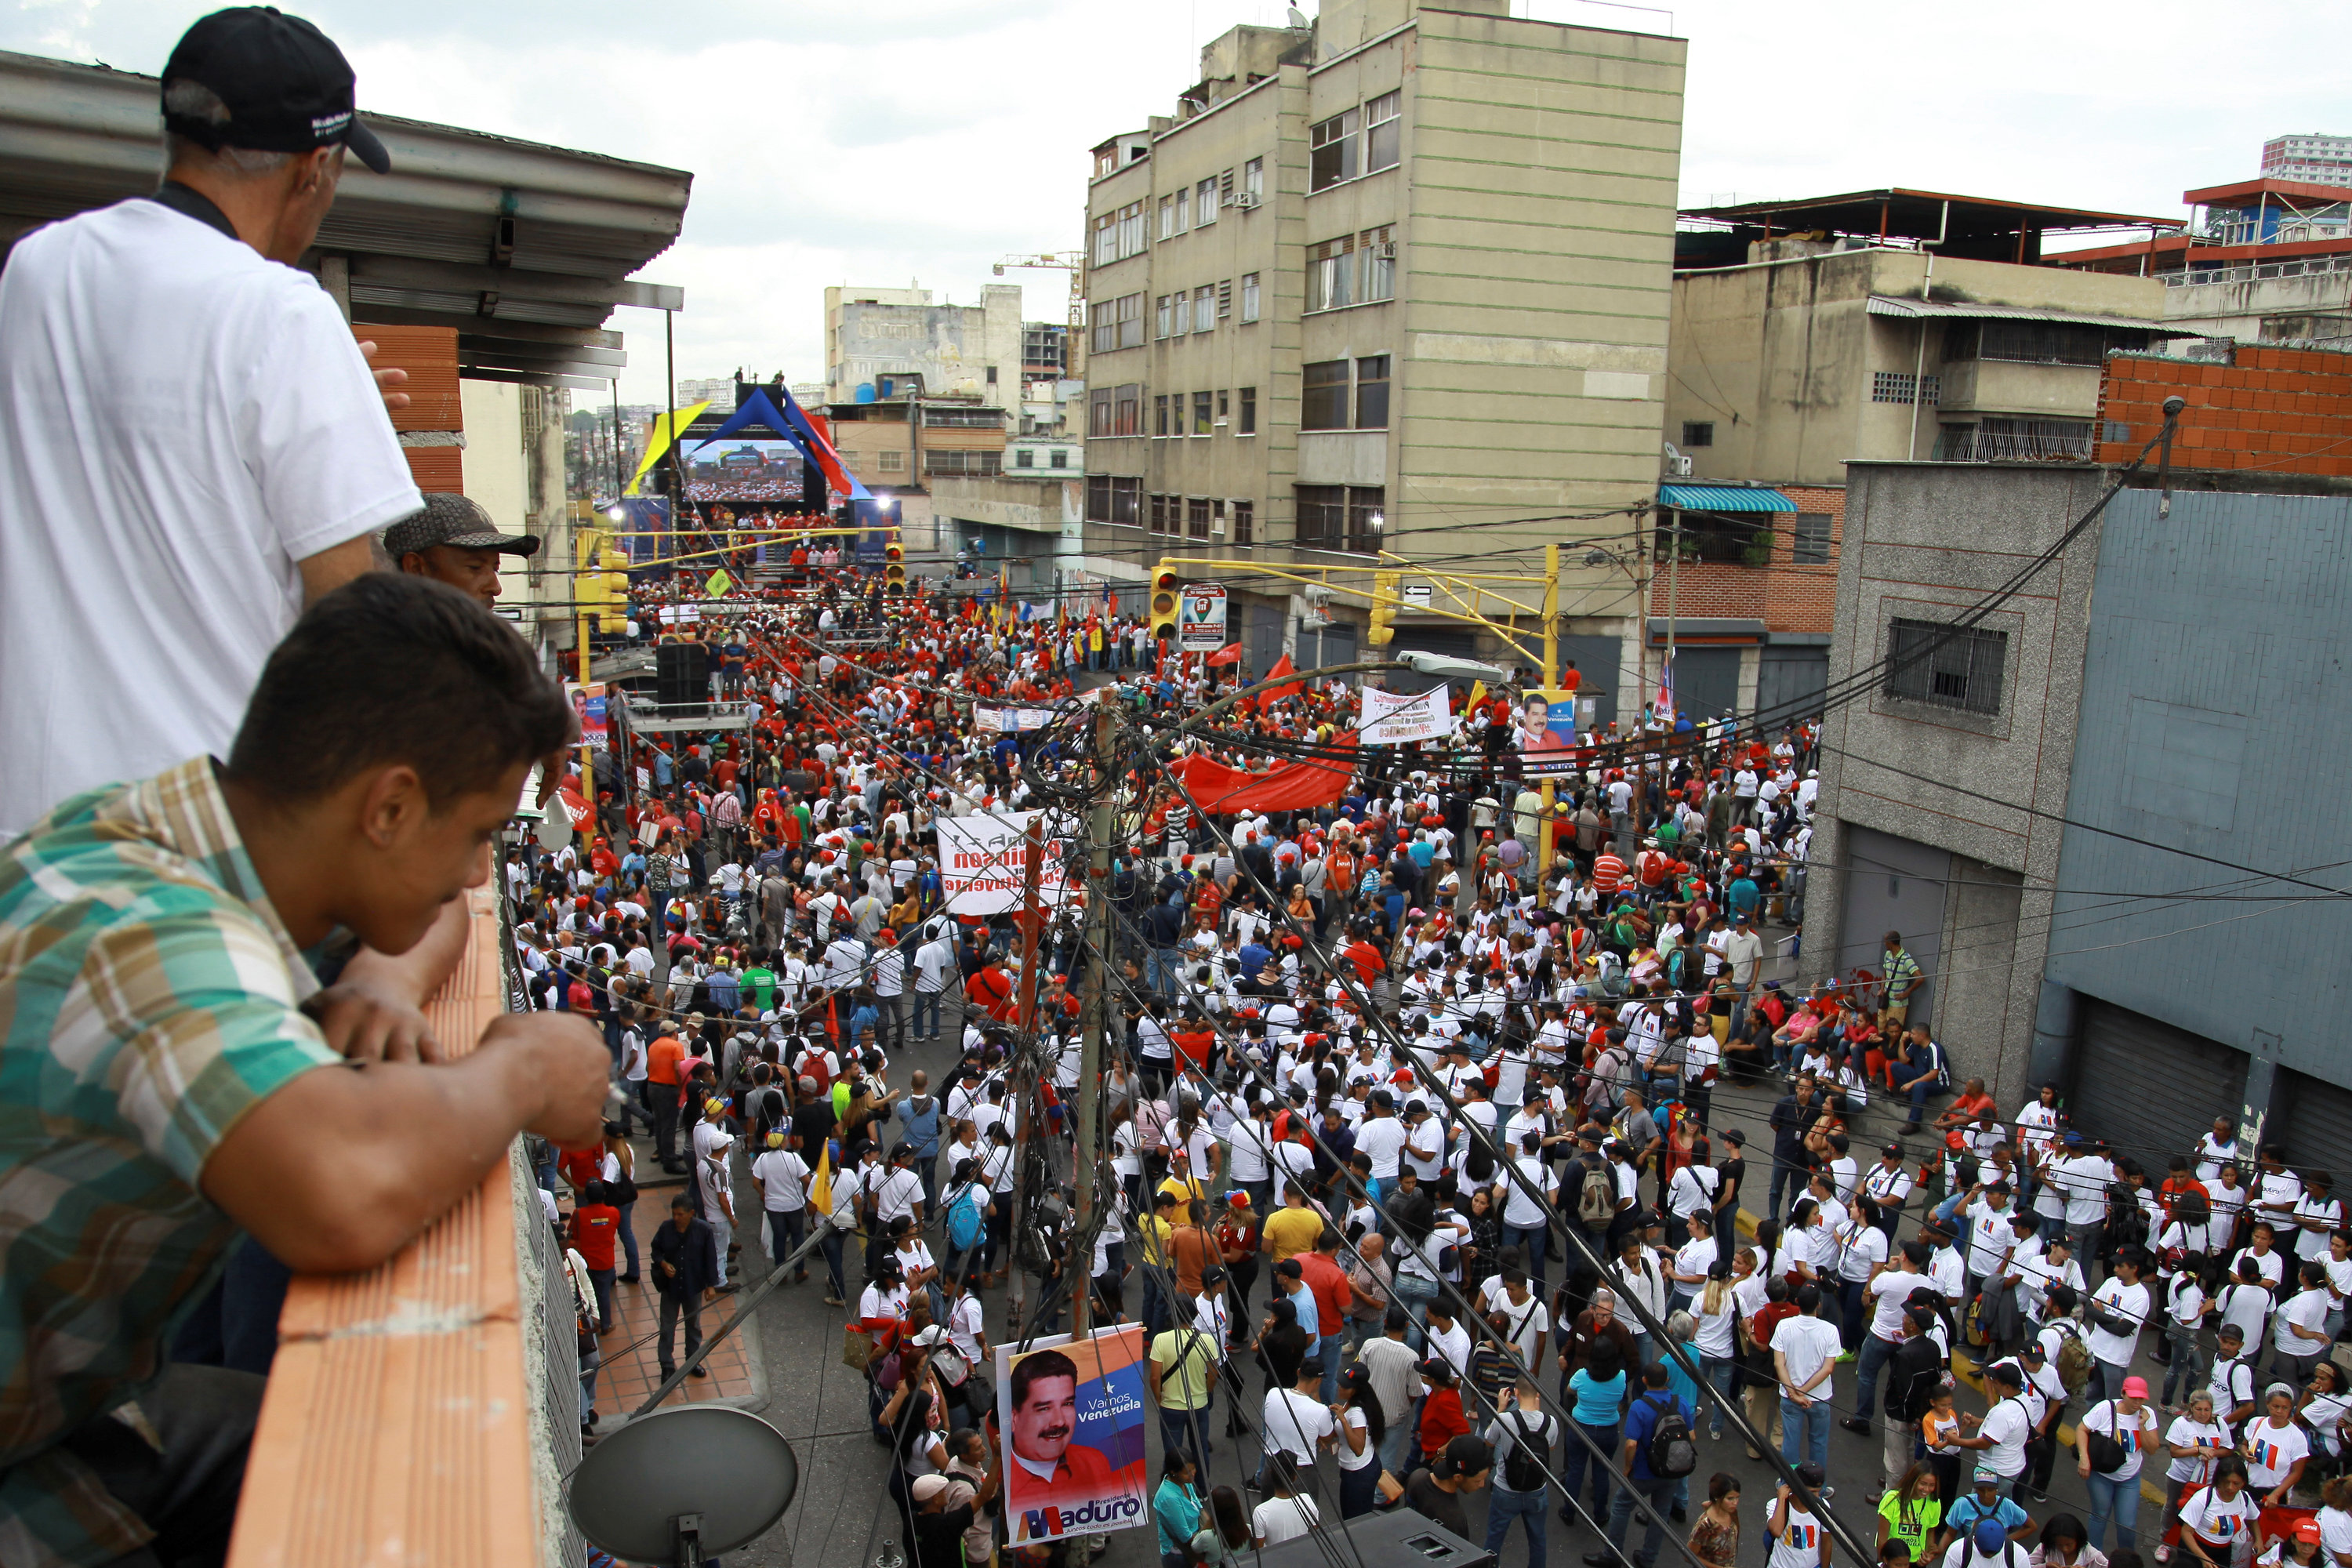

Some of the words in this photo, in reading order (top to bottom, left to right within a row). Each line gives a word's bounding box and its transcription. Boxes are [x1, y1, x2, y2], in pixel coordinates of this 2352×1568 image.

[580, 733, 606, 743] aduro
[2262, 1186, 2280, 1195] aduro
[1087, 1392, 1131, 1410] Vamos
[1077, 1399, 1142, 1424] Venezuela
[1095, 1493, 1131, 1505] Presidente
[1016, 1497, 1140, 1541] Maduro
[1065, 1526, 1086, 1534] Juntos
